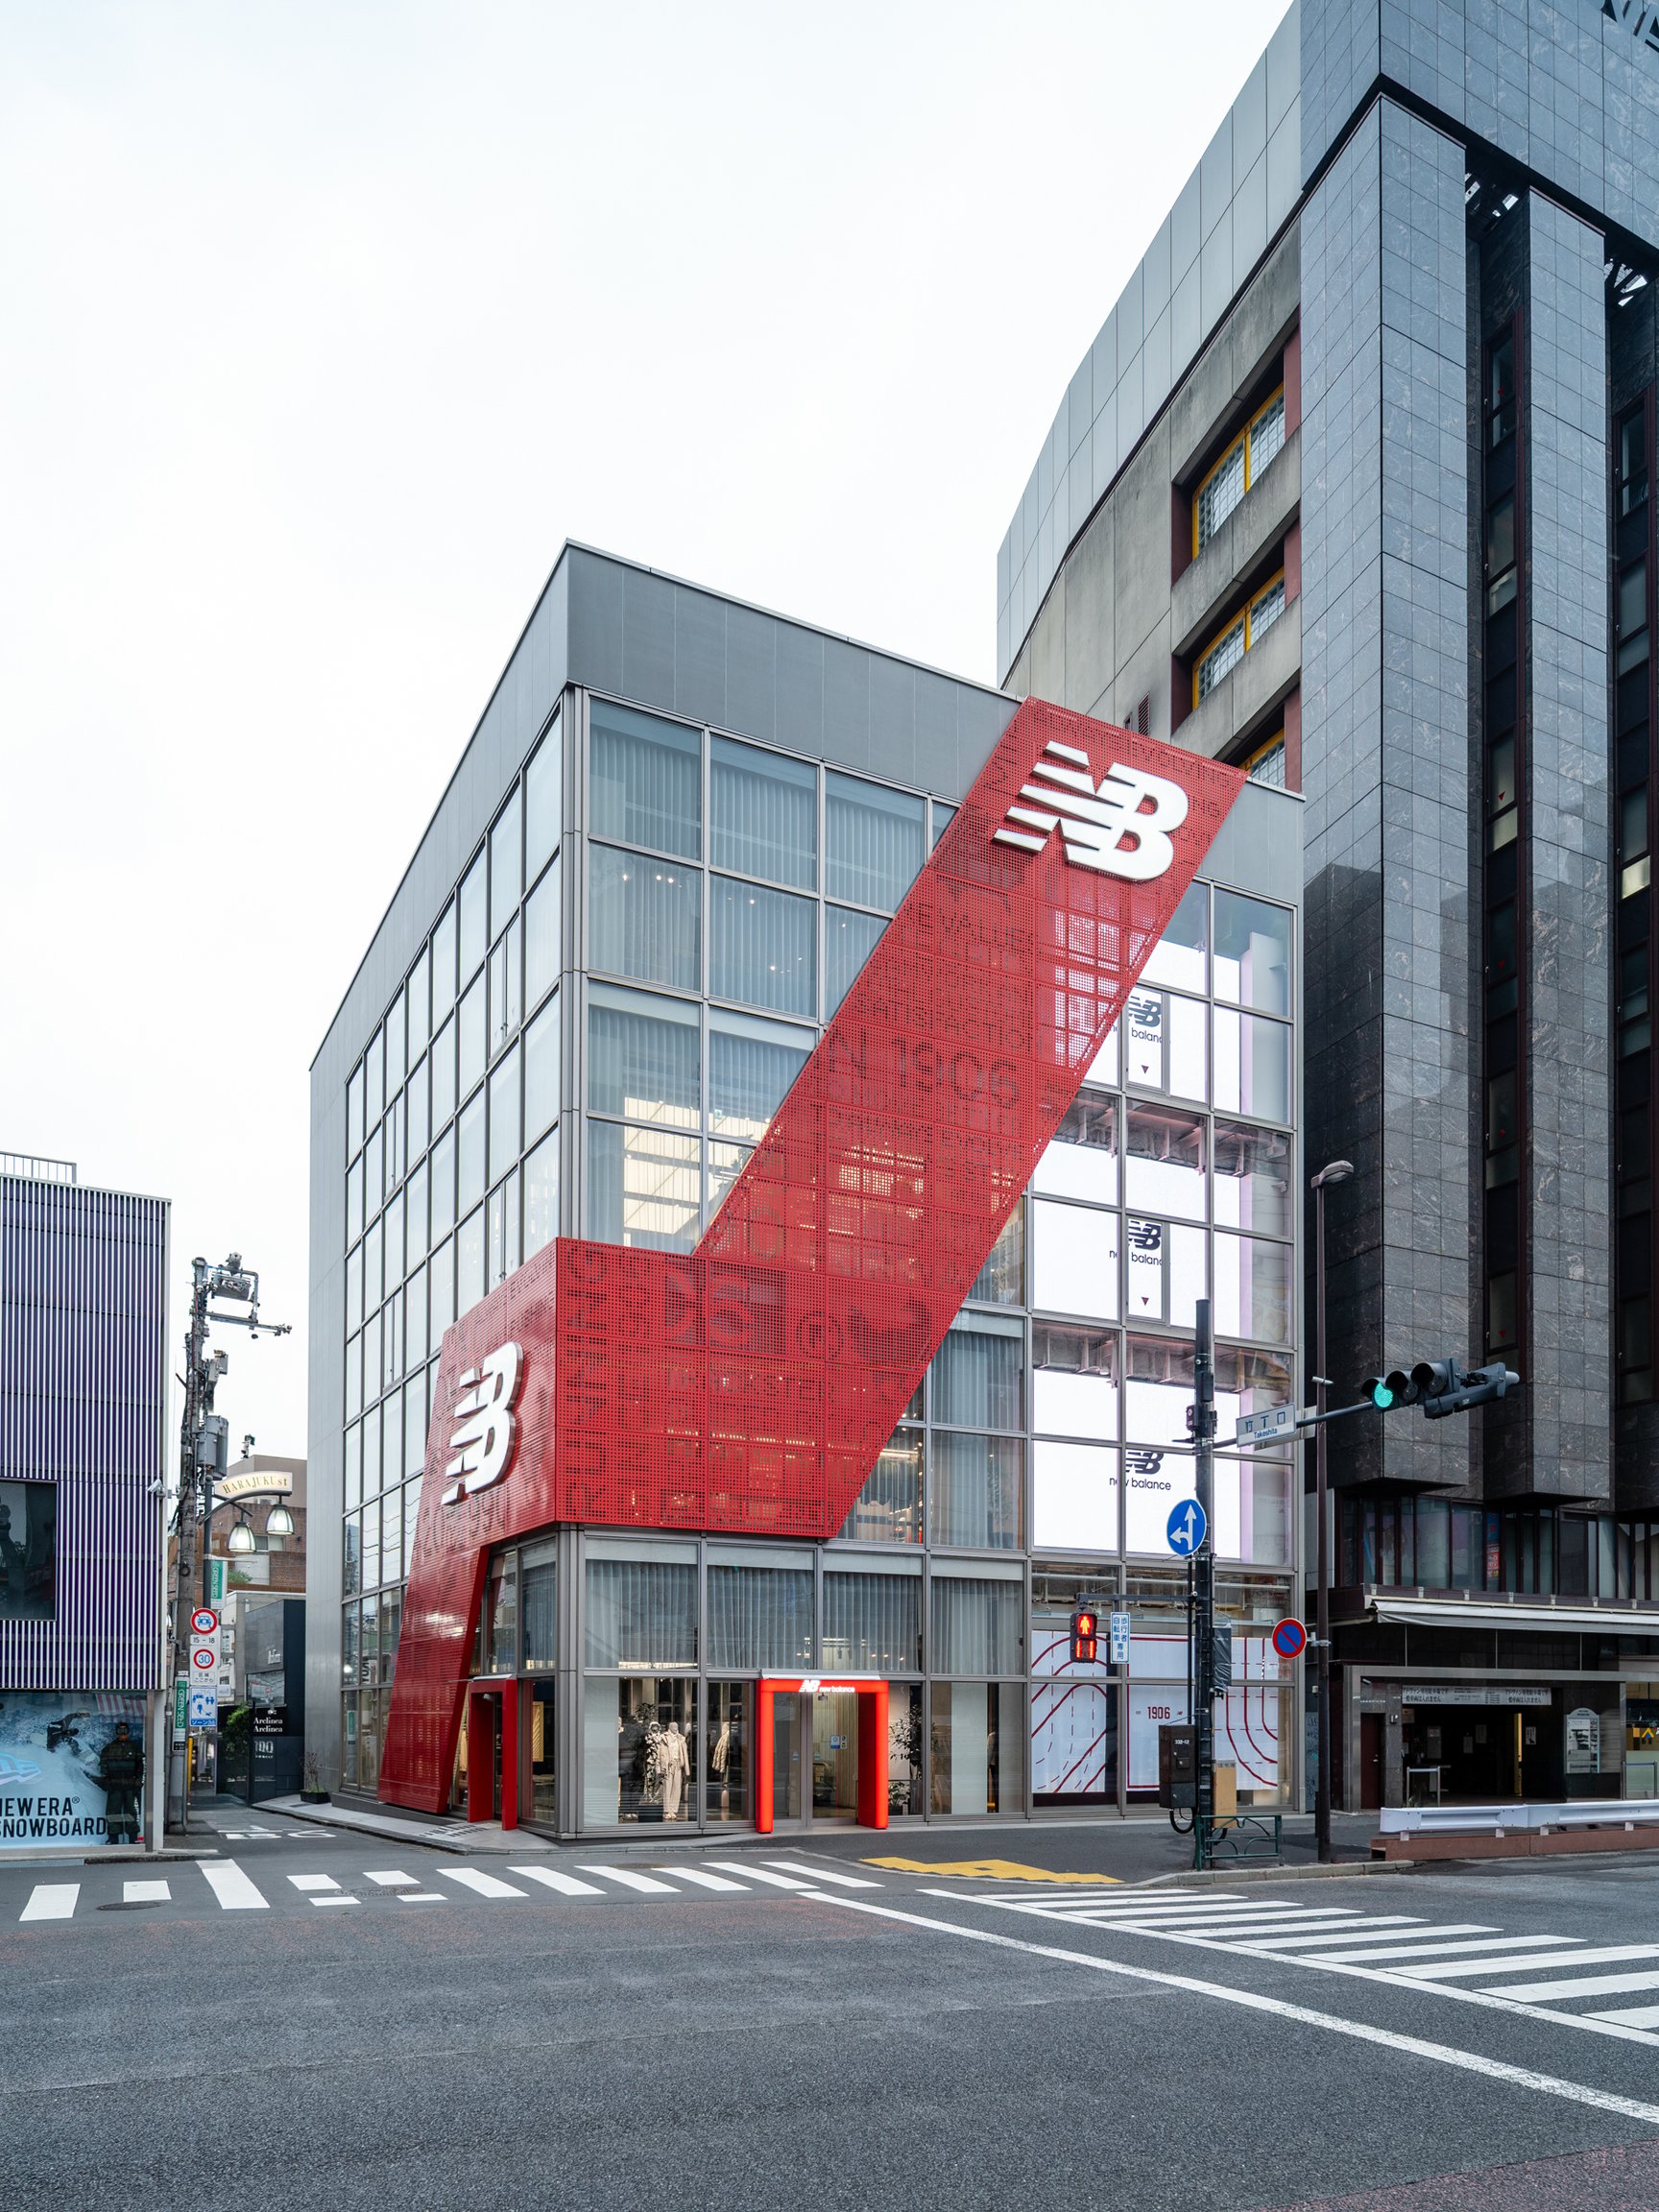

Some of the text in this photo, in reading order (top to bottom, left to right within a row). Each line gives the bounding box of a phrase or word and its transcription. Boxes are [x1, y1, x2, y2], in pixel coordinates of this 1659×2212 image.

[1254, 1428, 1278, 1439] Takeshita
[223, 1476, 276, 1494] HARAJUKU
[1131, 1478, 1171, 1491] balance
[198, 1654, 210, 1665] 30
[1147, 1706, 1170, 1719] 1906
[0, 1817, 107, 1838] NOWBOARD
